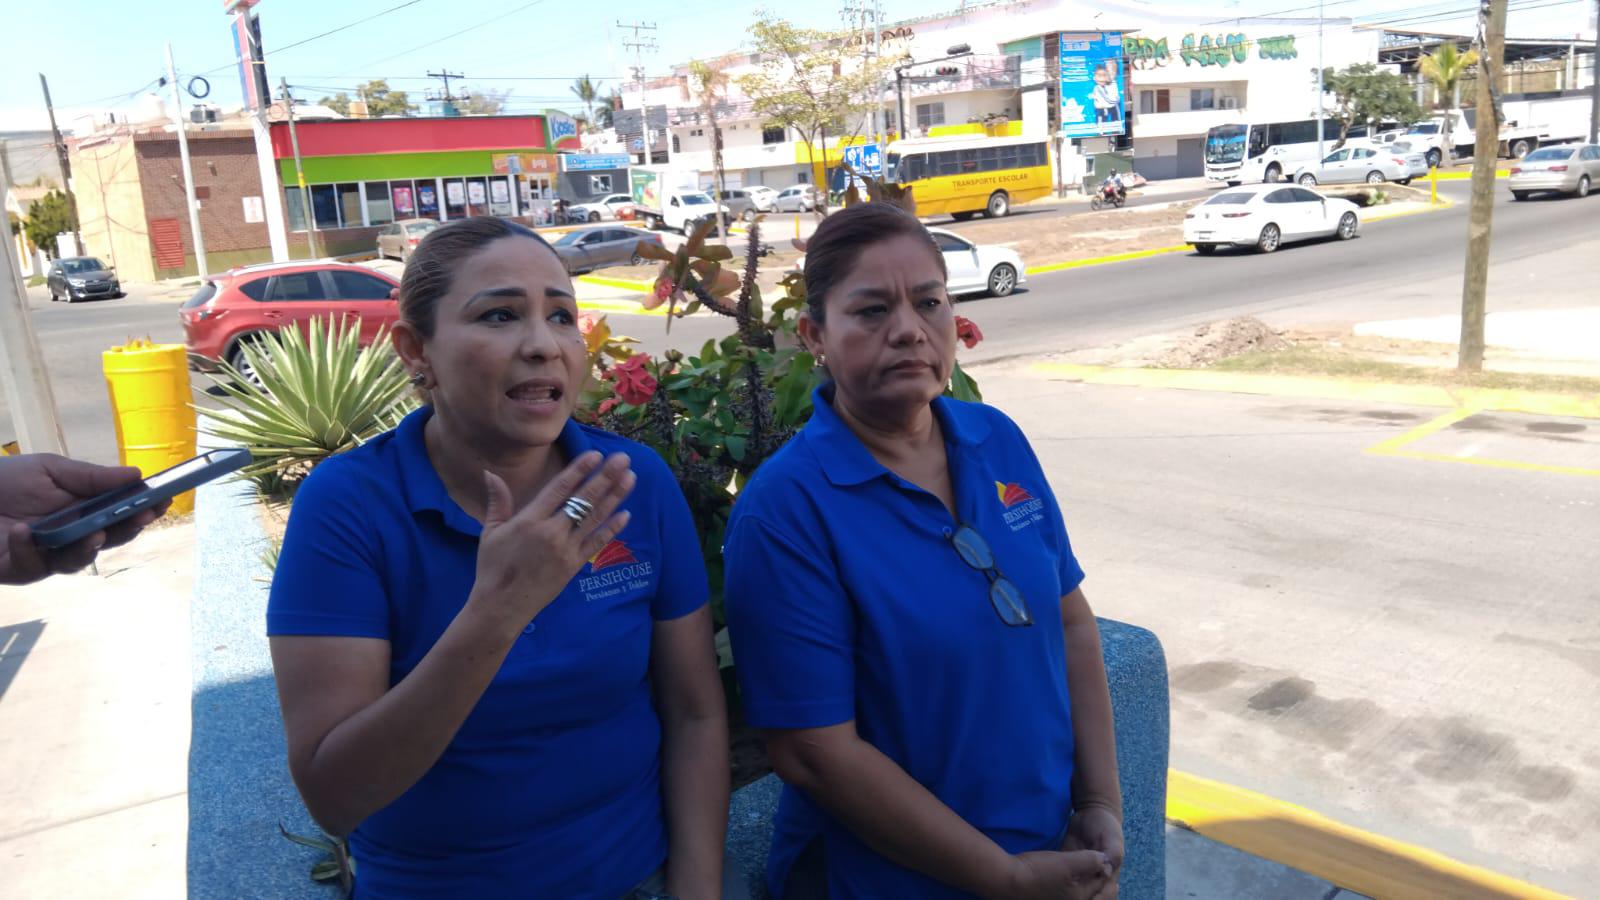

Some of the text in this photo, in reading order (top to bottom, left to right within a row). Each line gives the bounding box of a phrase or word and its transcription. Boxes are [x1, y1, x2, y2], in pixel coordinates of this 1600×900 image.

[952, 173, 1028, 188] TRANSPORTE ESCOLAR
[579, 561, 652, 592] PERSIHOUSE
